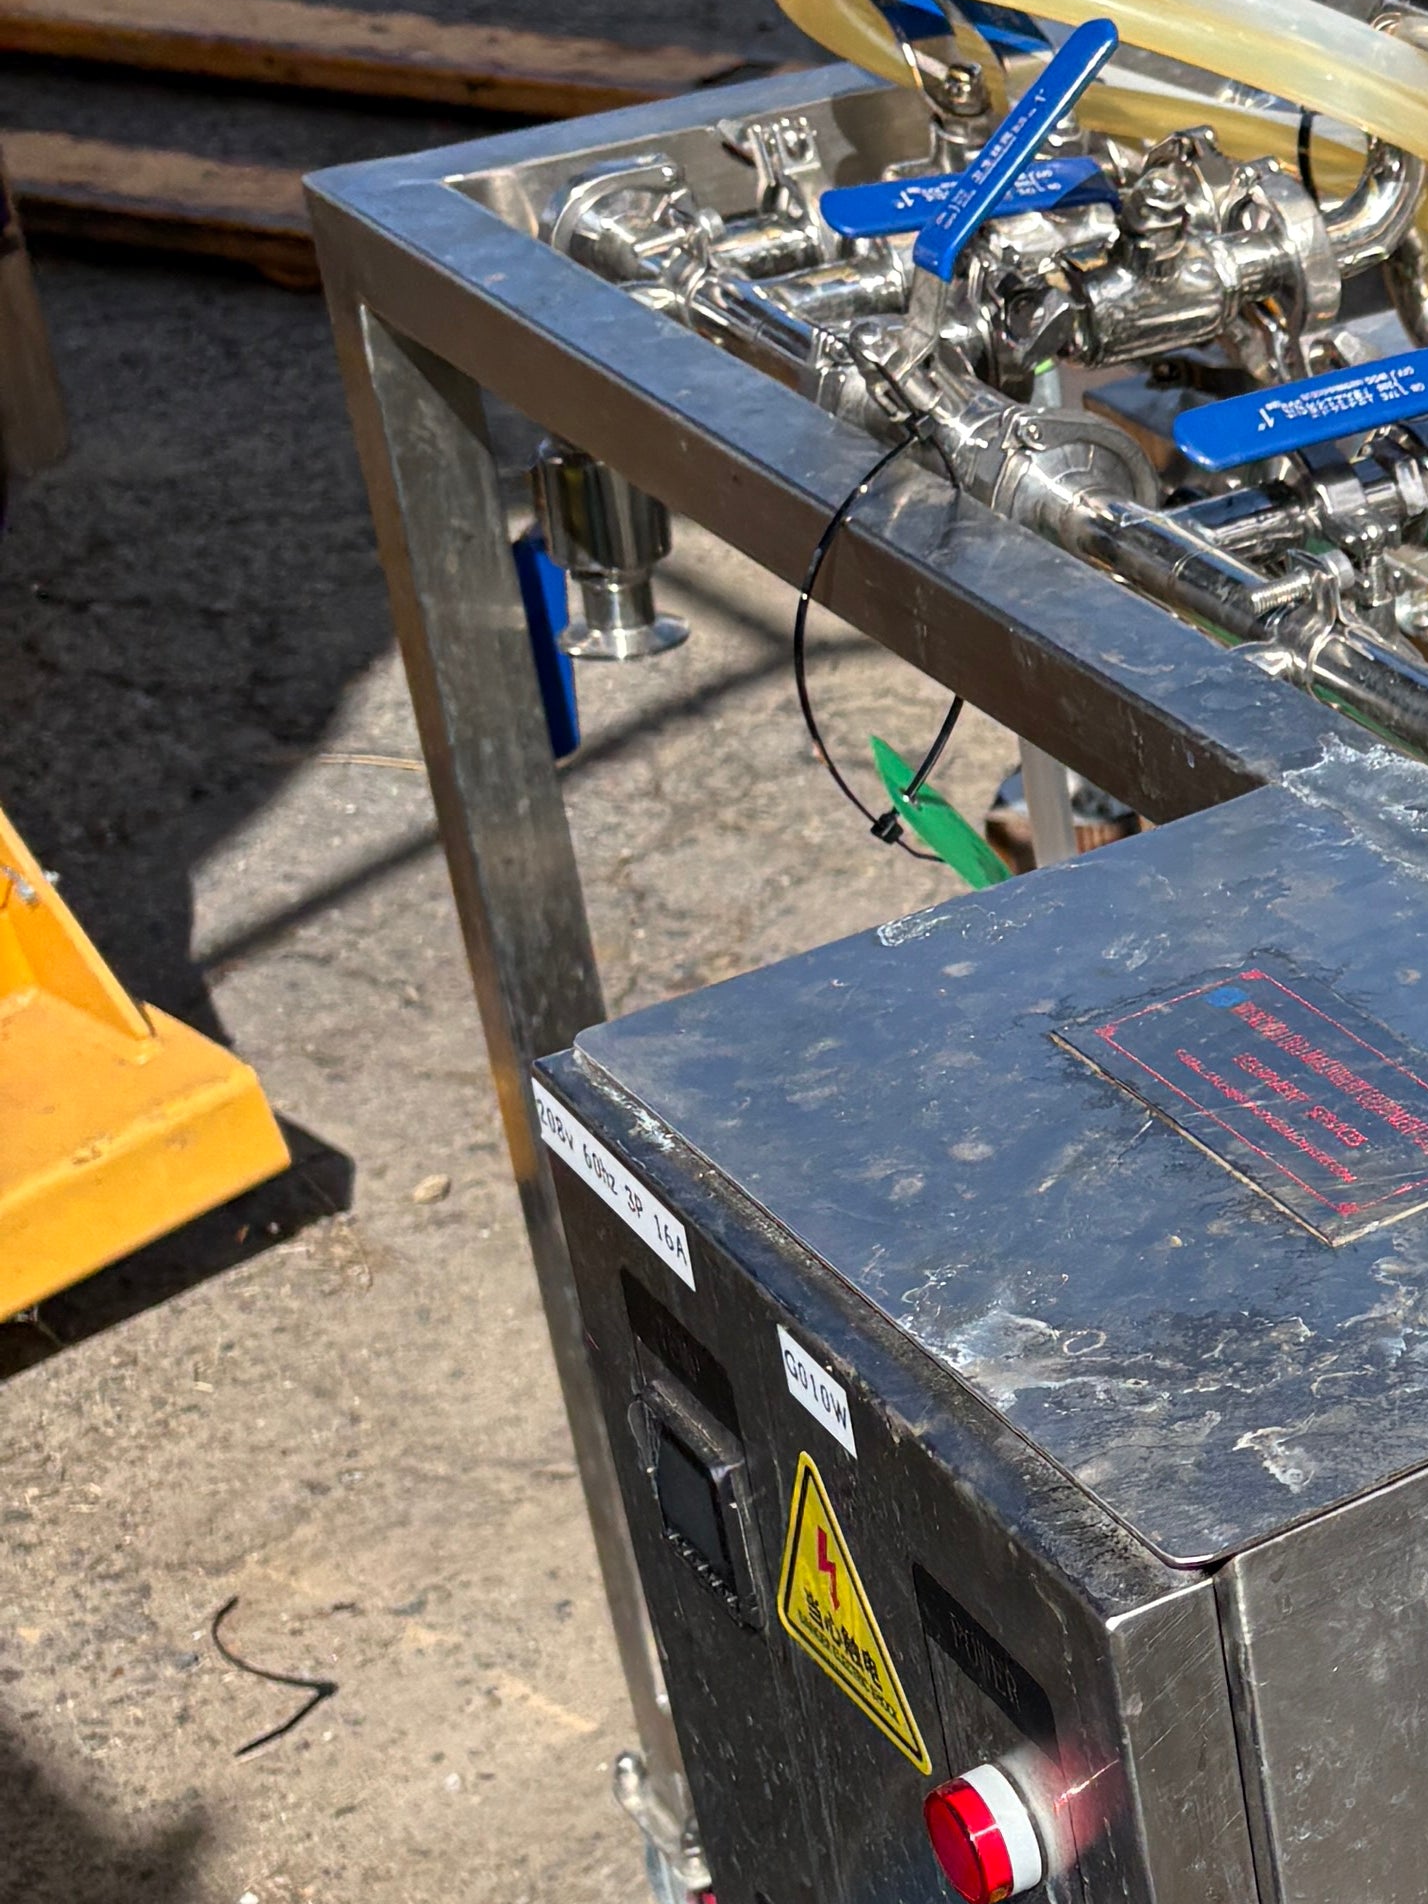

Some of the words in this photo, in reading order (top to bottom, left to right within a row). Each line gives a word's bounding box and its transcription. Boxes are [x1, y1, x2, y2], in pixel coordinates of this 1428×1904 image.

[536, 1098, 574, 1150] 208v
[624, 1185, 643, 1219] 3P
[653, 1214, 687, 1266] 16A
[784, 1349, 847, 1430] G010W
